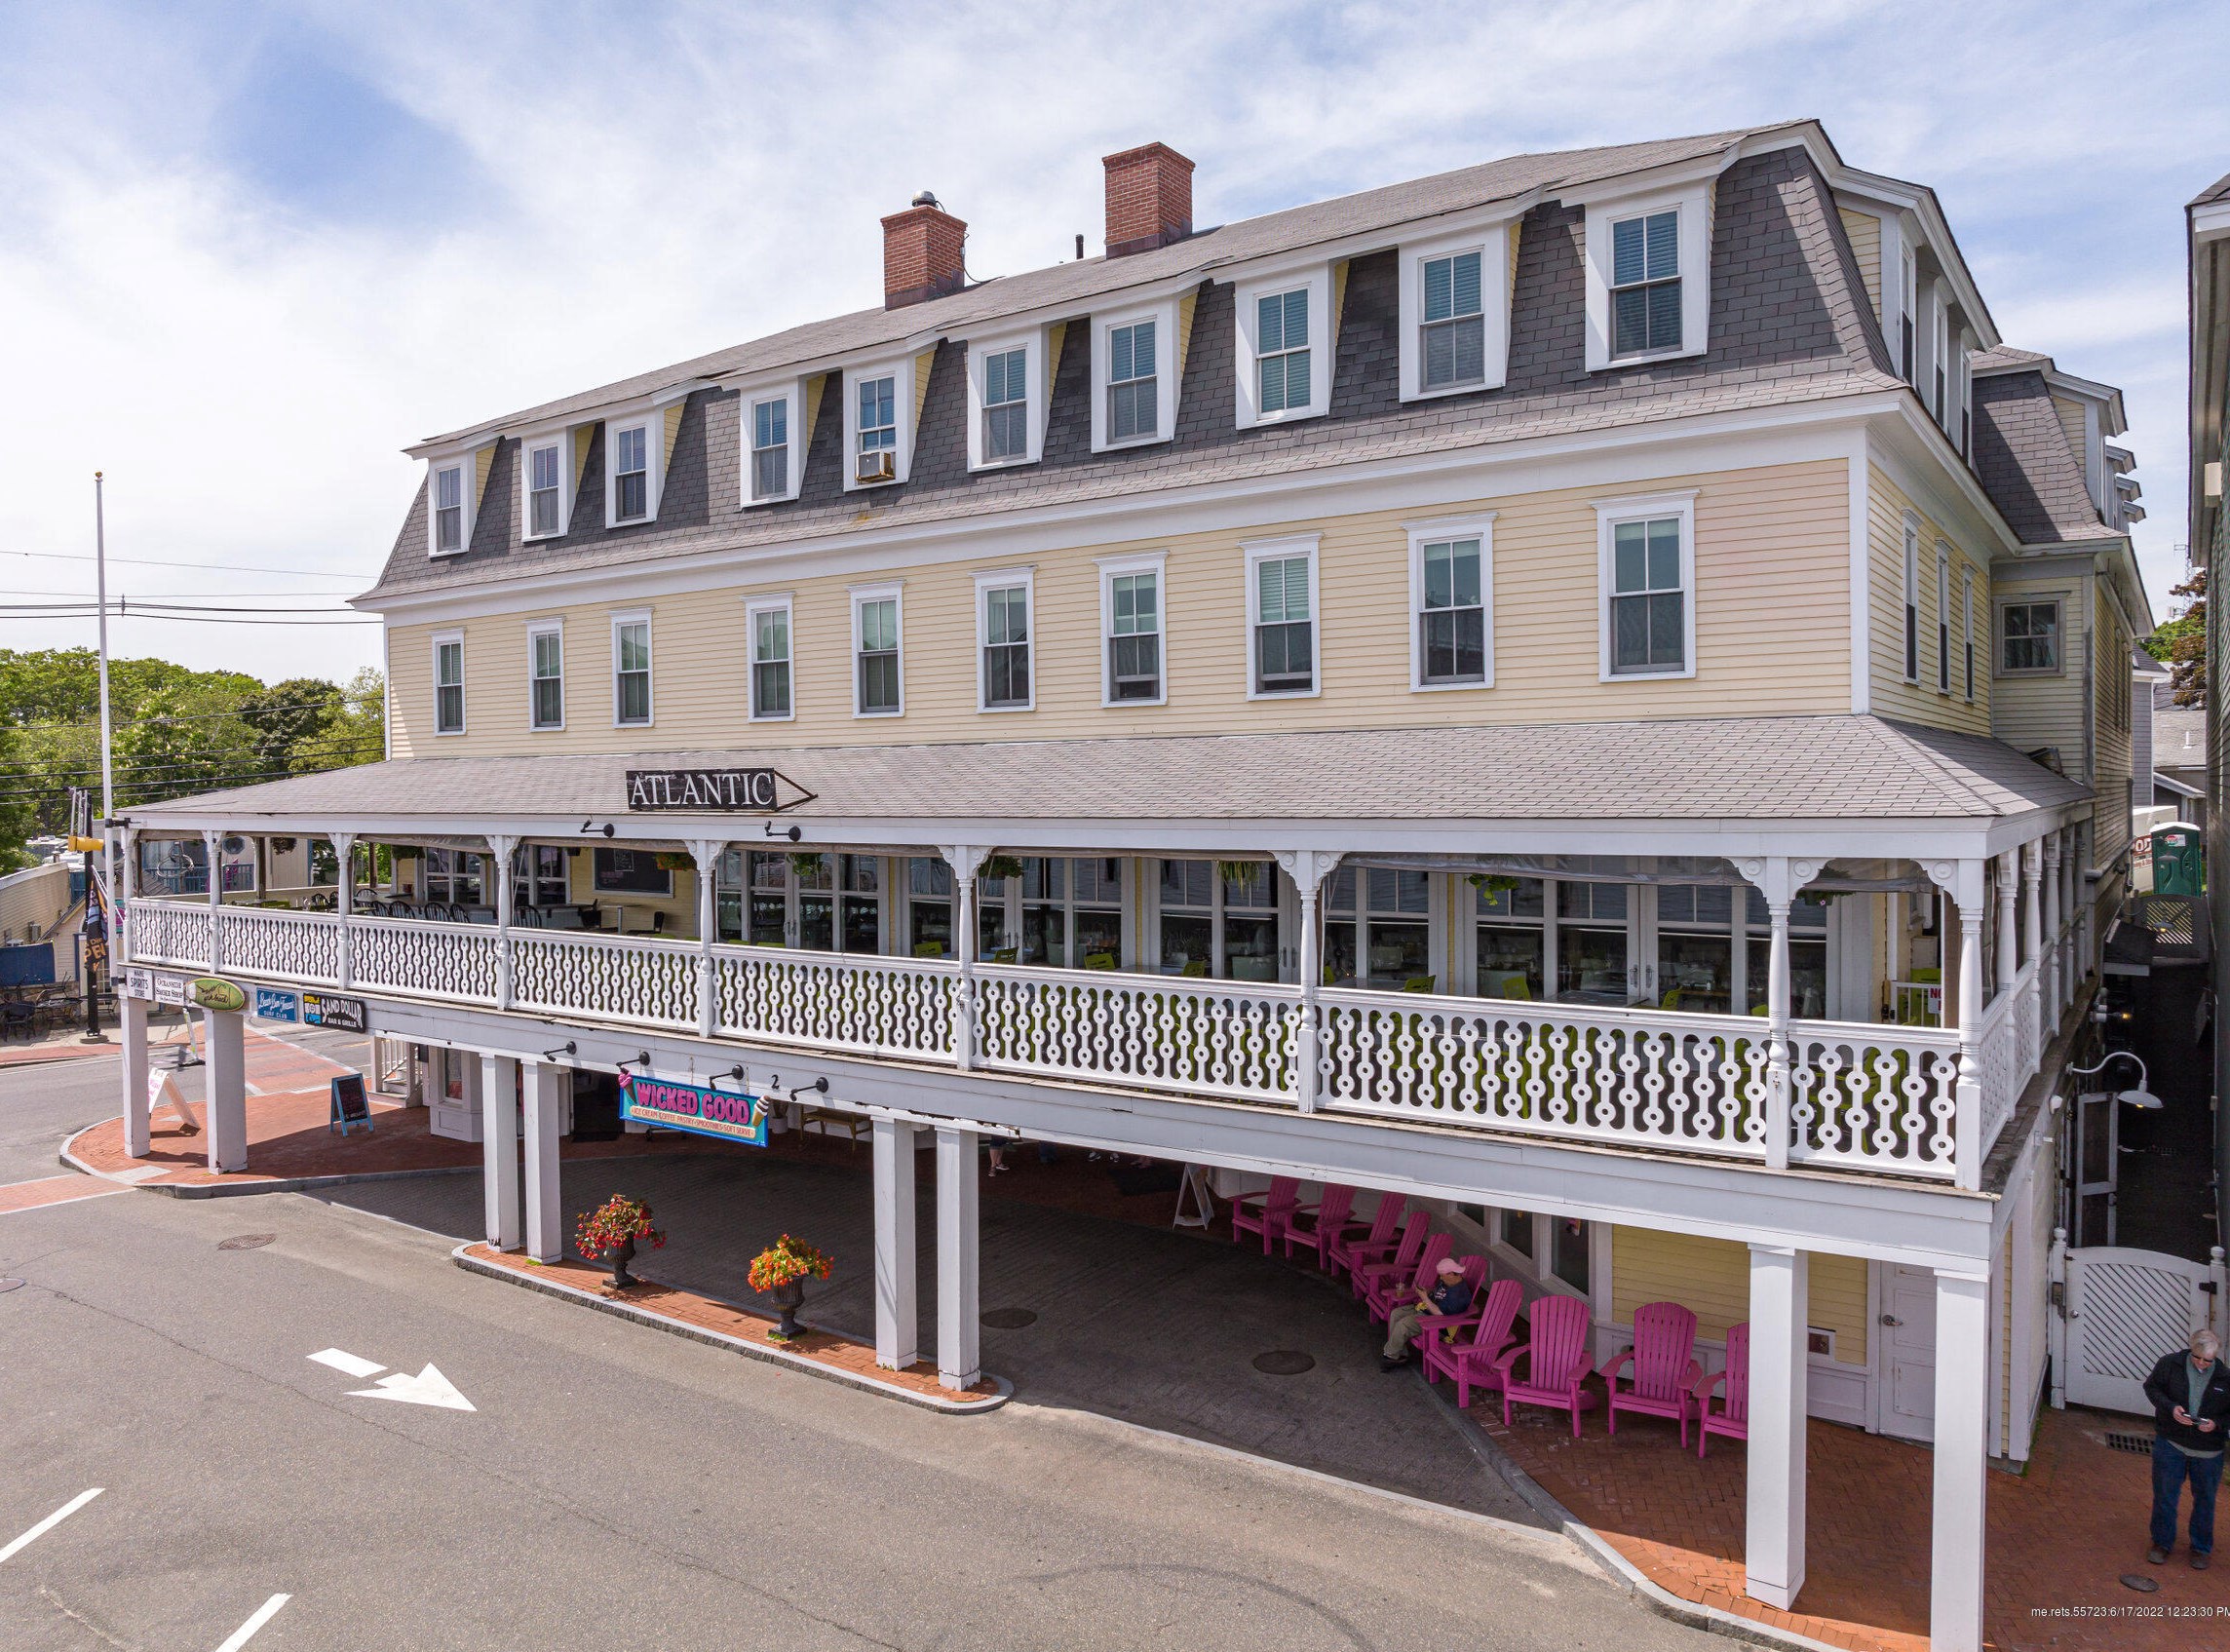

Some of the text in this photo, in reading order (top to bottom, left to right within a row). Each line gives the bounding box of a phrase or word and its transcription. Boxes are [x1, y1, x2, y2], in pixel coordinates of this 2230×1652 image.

[630, 773, 773, 805] ATLANTIC
[130, 978, 148, 989] SPIRITS
[321, 998, 340, 1023] SAND
[771, 1074, 780, 1090] 2
[635, 1082, 750, 1125] WICKED GOOD
